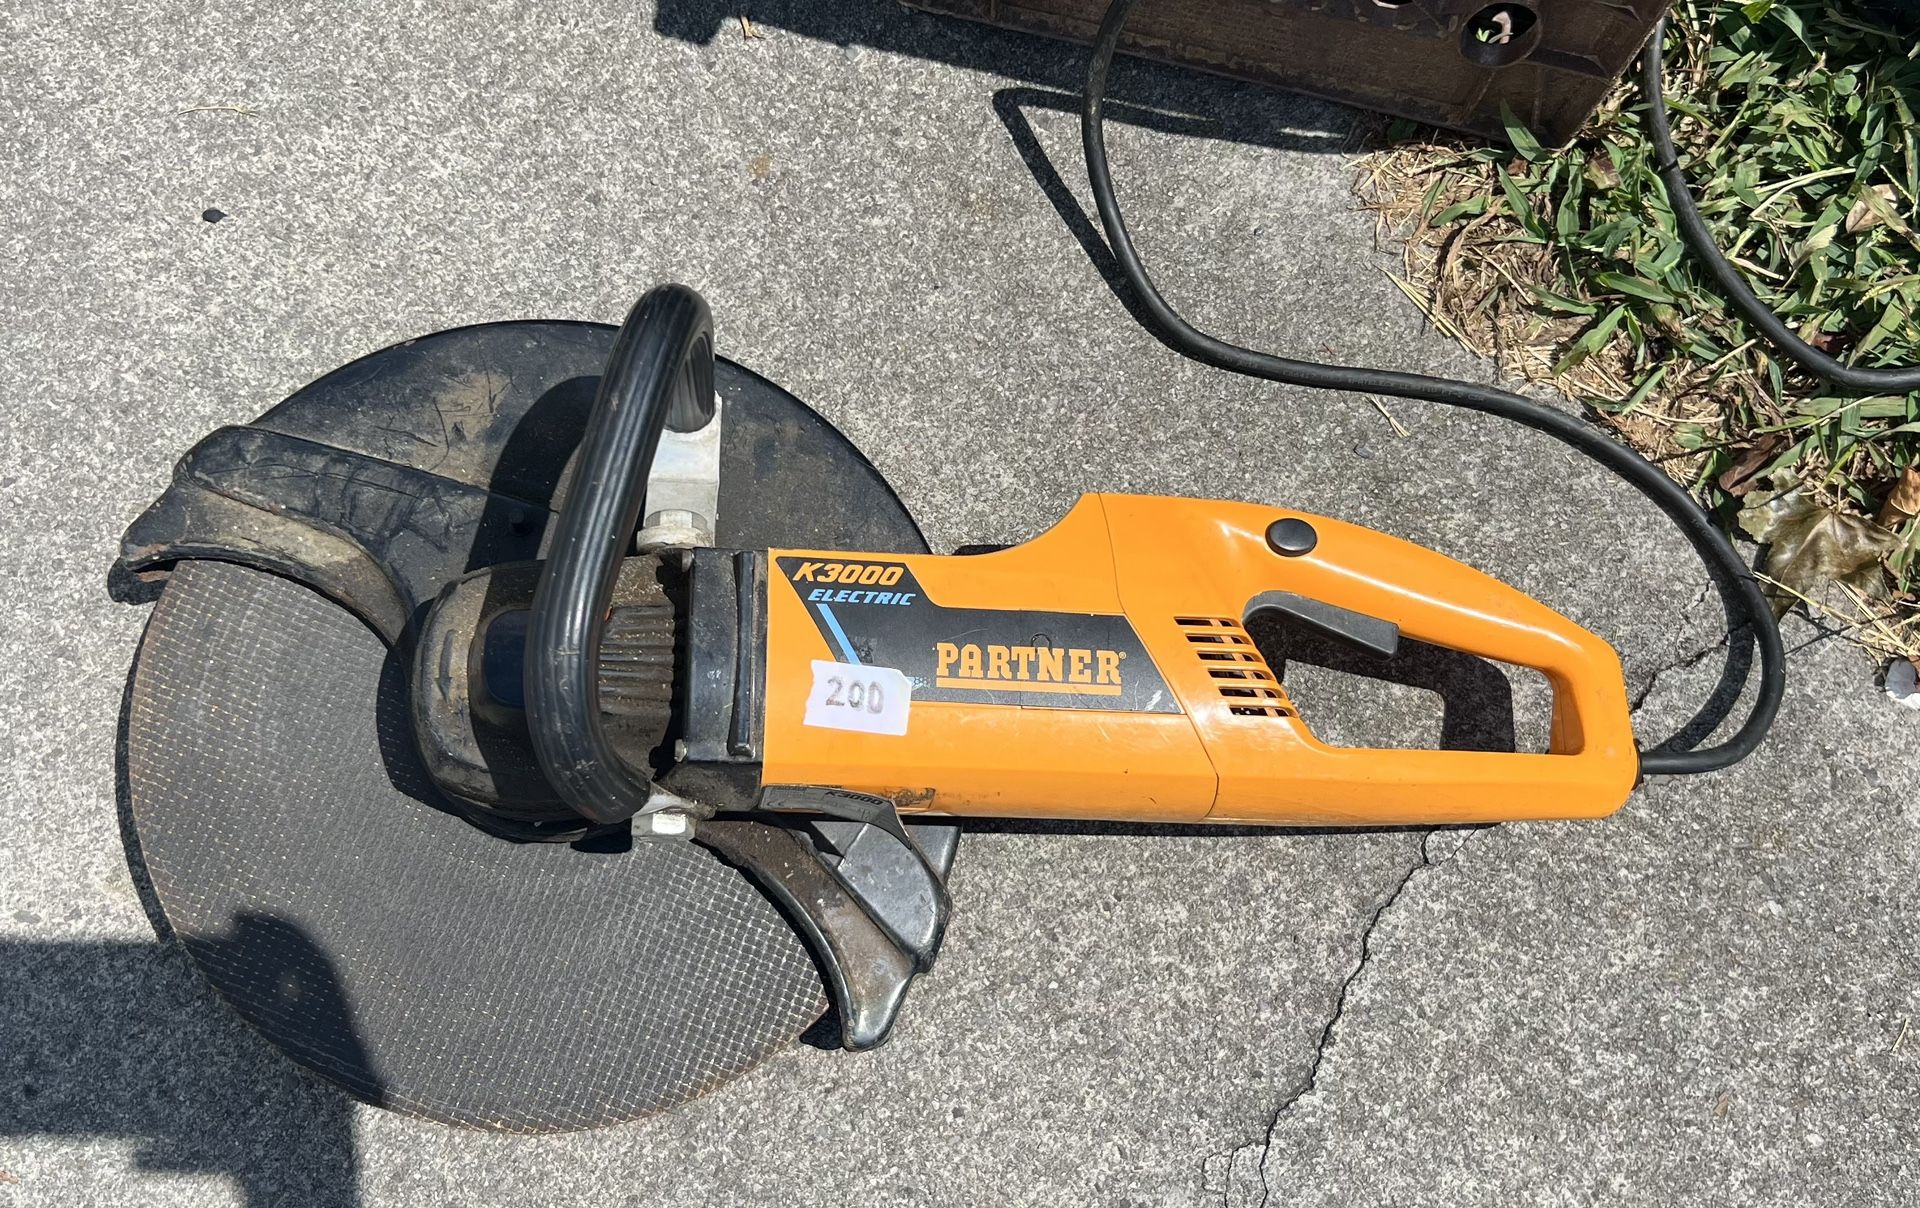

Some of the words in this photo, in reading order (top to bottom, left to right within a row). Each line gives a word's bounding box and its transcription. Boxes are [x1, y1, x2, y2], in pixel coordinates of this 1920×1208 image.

[792, 561, 905, 586] K3000
[807, 588, 917, 606] ELECTRIC
[825, 676, 885, 714] 200
[824, 790, 883, 806] K3000
